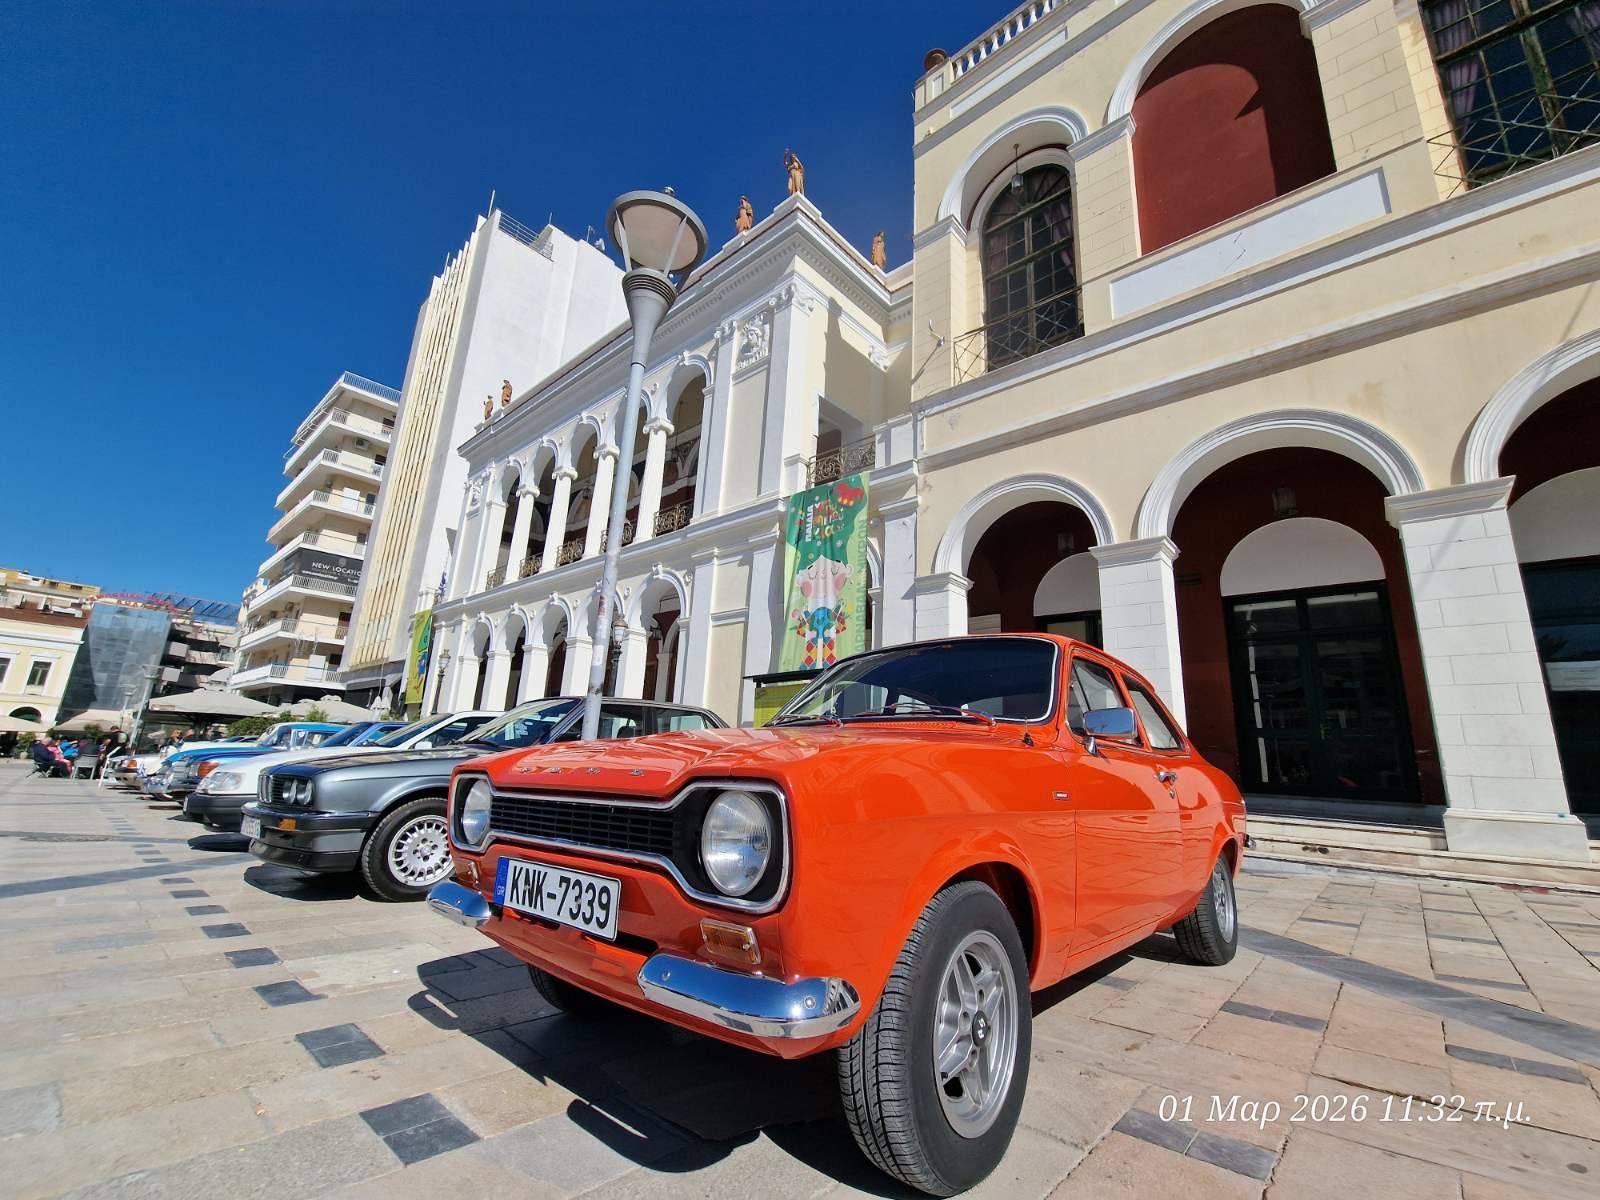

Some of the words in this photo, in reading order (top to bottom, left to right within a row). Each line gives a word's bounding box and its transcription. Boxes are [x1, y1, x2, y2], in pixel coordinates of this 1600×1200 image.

[312, 561, 330, 570] NEW
[332, 566, 361, 577] LOCATIO
[510, 865, 612, 930] KNK-7339
